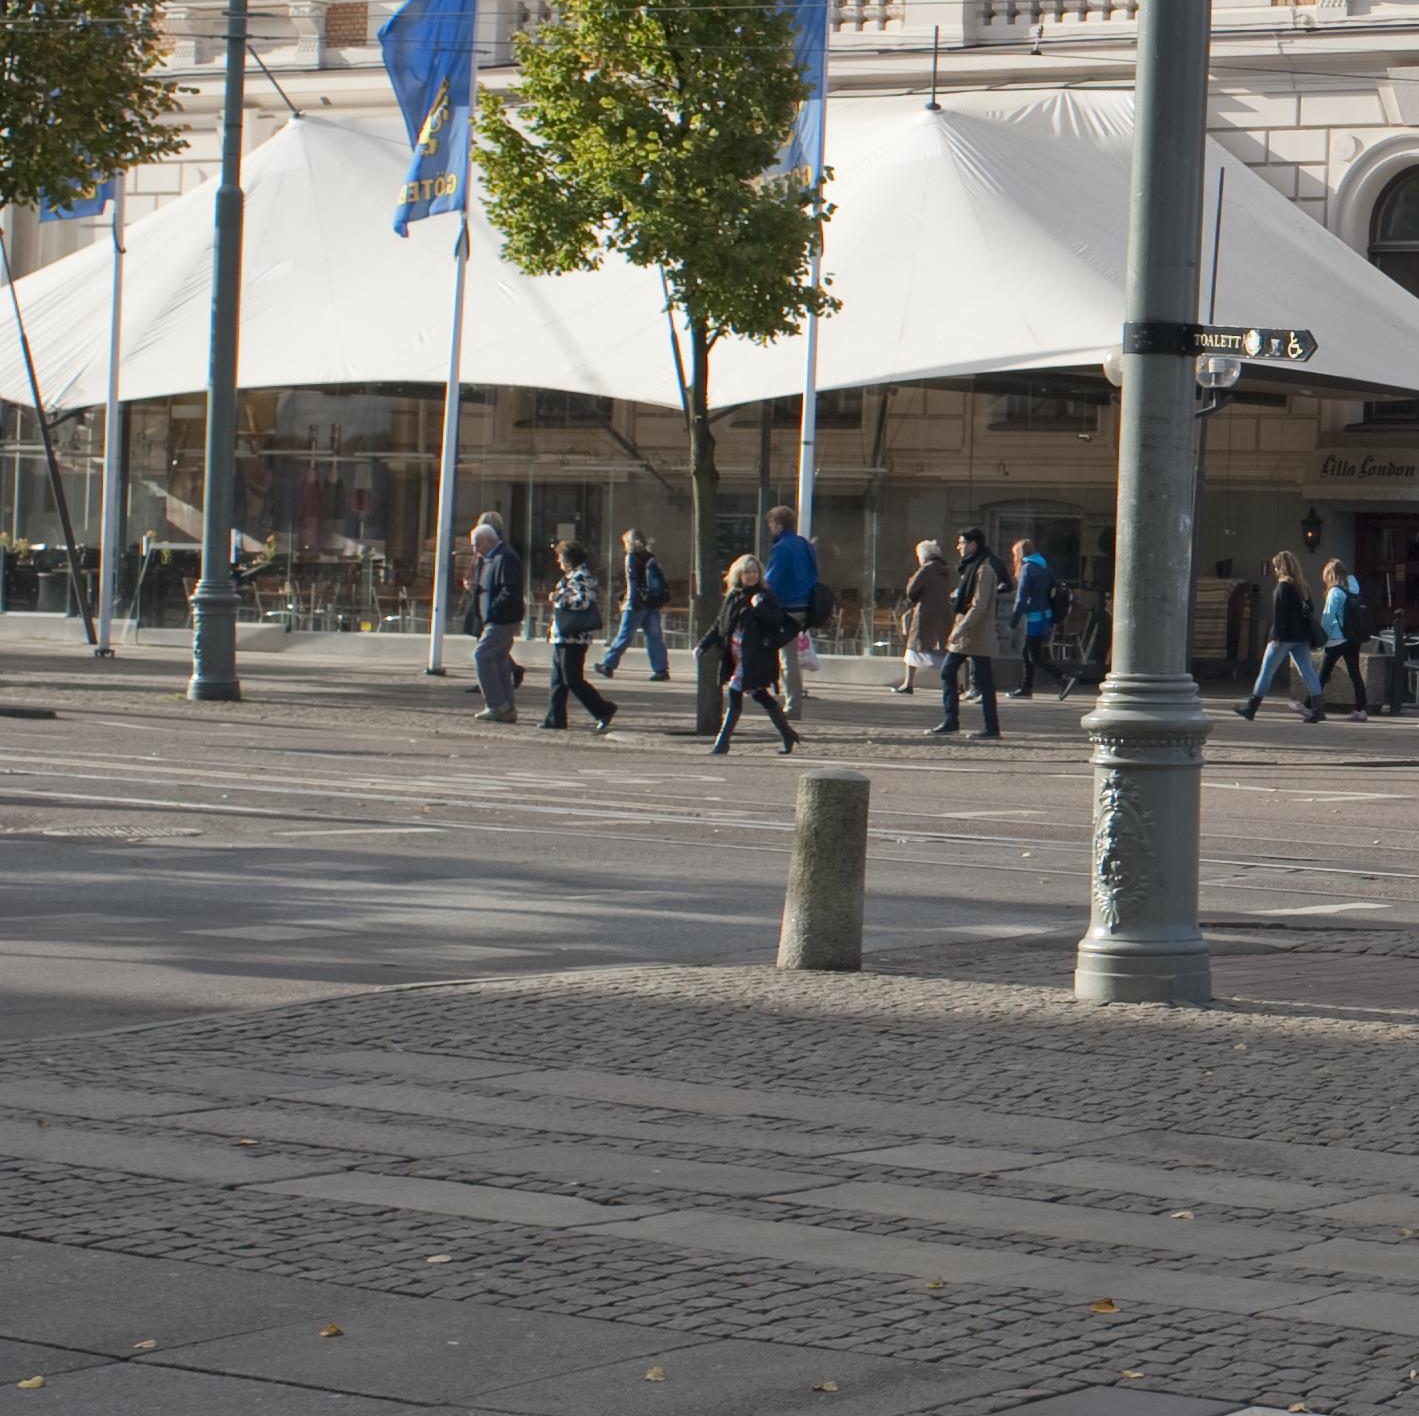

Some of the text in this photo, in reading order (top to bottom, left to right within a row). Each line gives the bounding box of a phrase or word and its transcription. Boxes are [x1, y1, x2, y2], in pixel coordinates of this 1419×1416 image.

[1194, 333, 1241, 349] TOALETT
[1322, 454, 1416, 478] Lilla London
